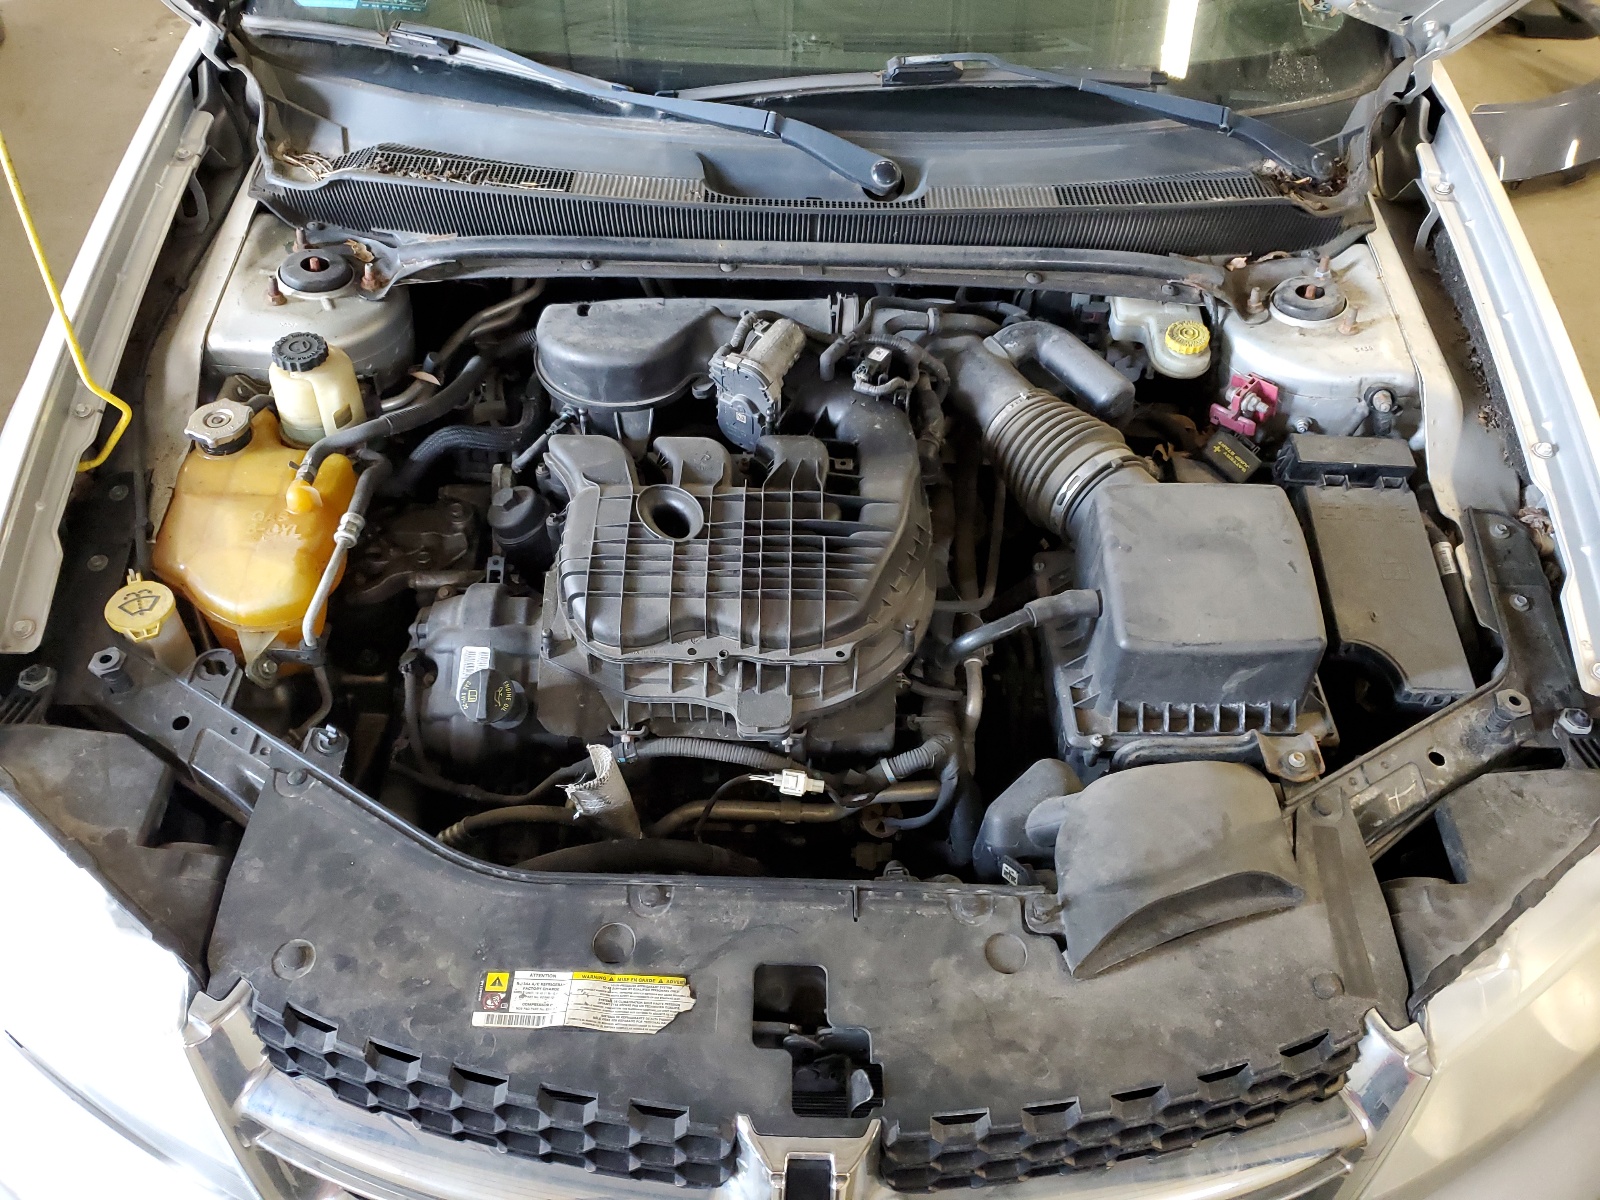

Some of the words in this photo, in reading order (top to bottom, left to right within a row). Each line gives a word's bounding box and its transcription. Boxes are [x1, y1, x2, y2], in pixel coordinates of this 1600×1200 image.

[1218, 441, 1236, 456] START
[1223, 451, 1247, 473] BATTERY
[1234, 455, 1250, 469] JUMP
[502, 680, 512, 701] ENGINE
[500, 703, 510, 712] OIL
